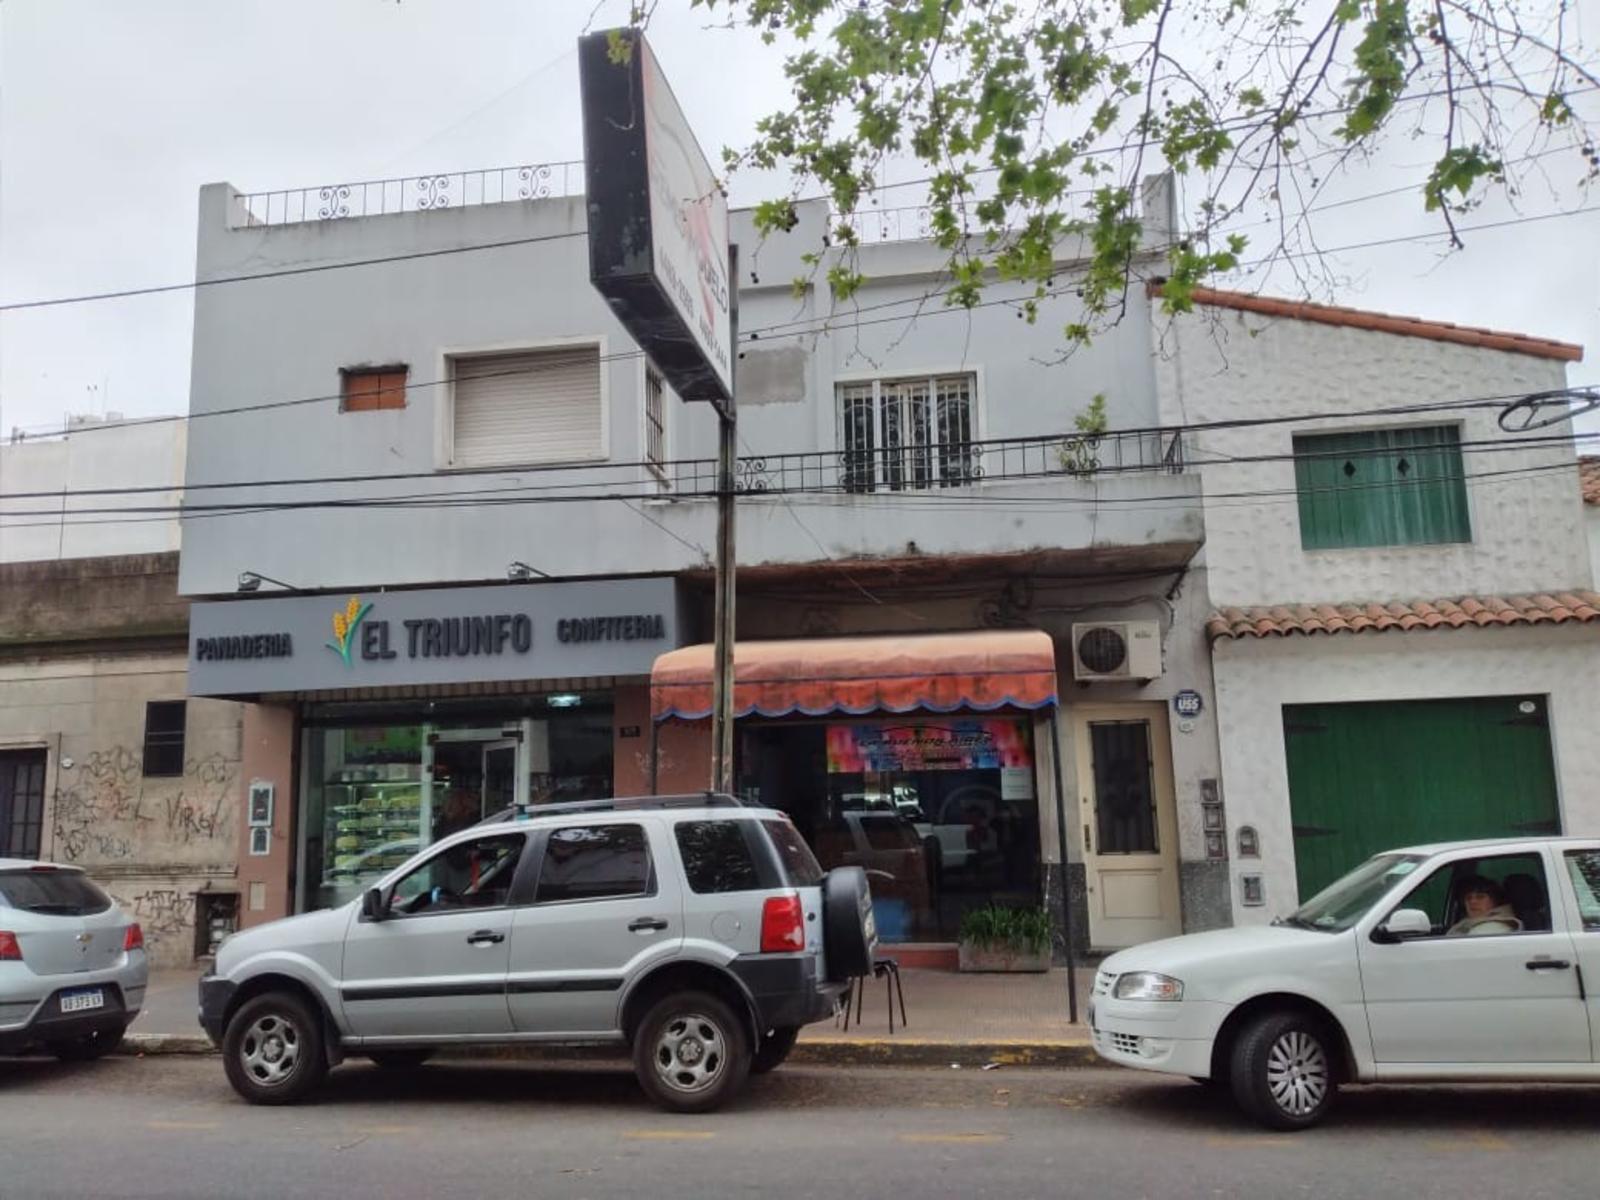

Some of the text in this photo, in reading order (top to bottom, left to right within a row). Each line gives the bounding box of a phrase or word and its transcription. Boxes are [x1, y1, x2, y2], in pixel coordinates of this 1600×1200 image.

[361, 613, 531, 660] EL TRIUNFO
[557, 614, 665, 643] CONFITERIA
[196, 634, 292, 660] PANADERIA
